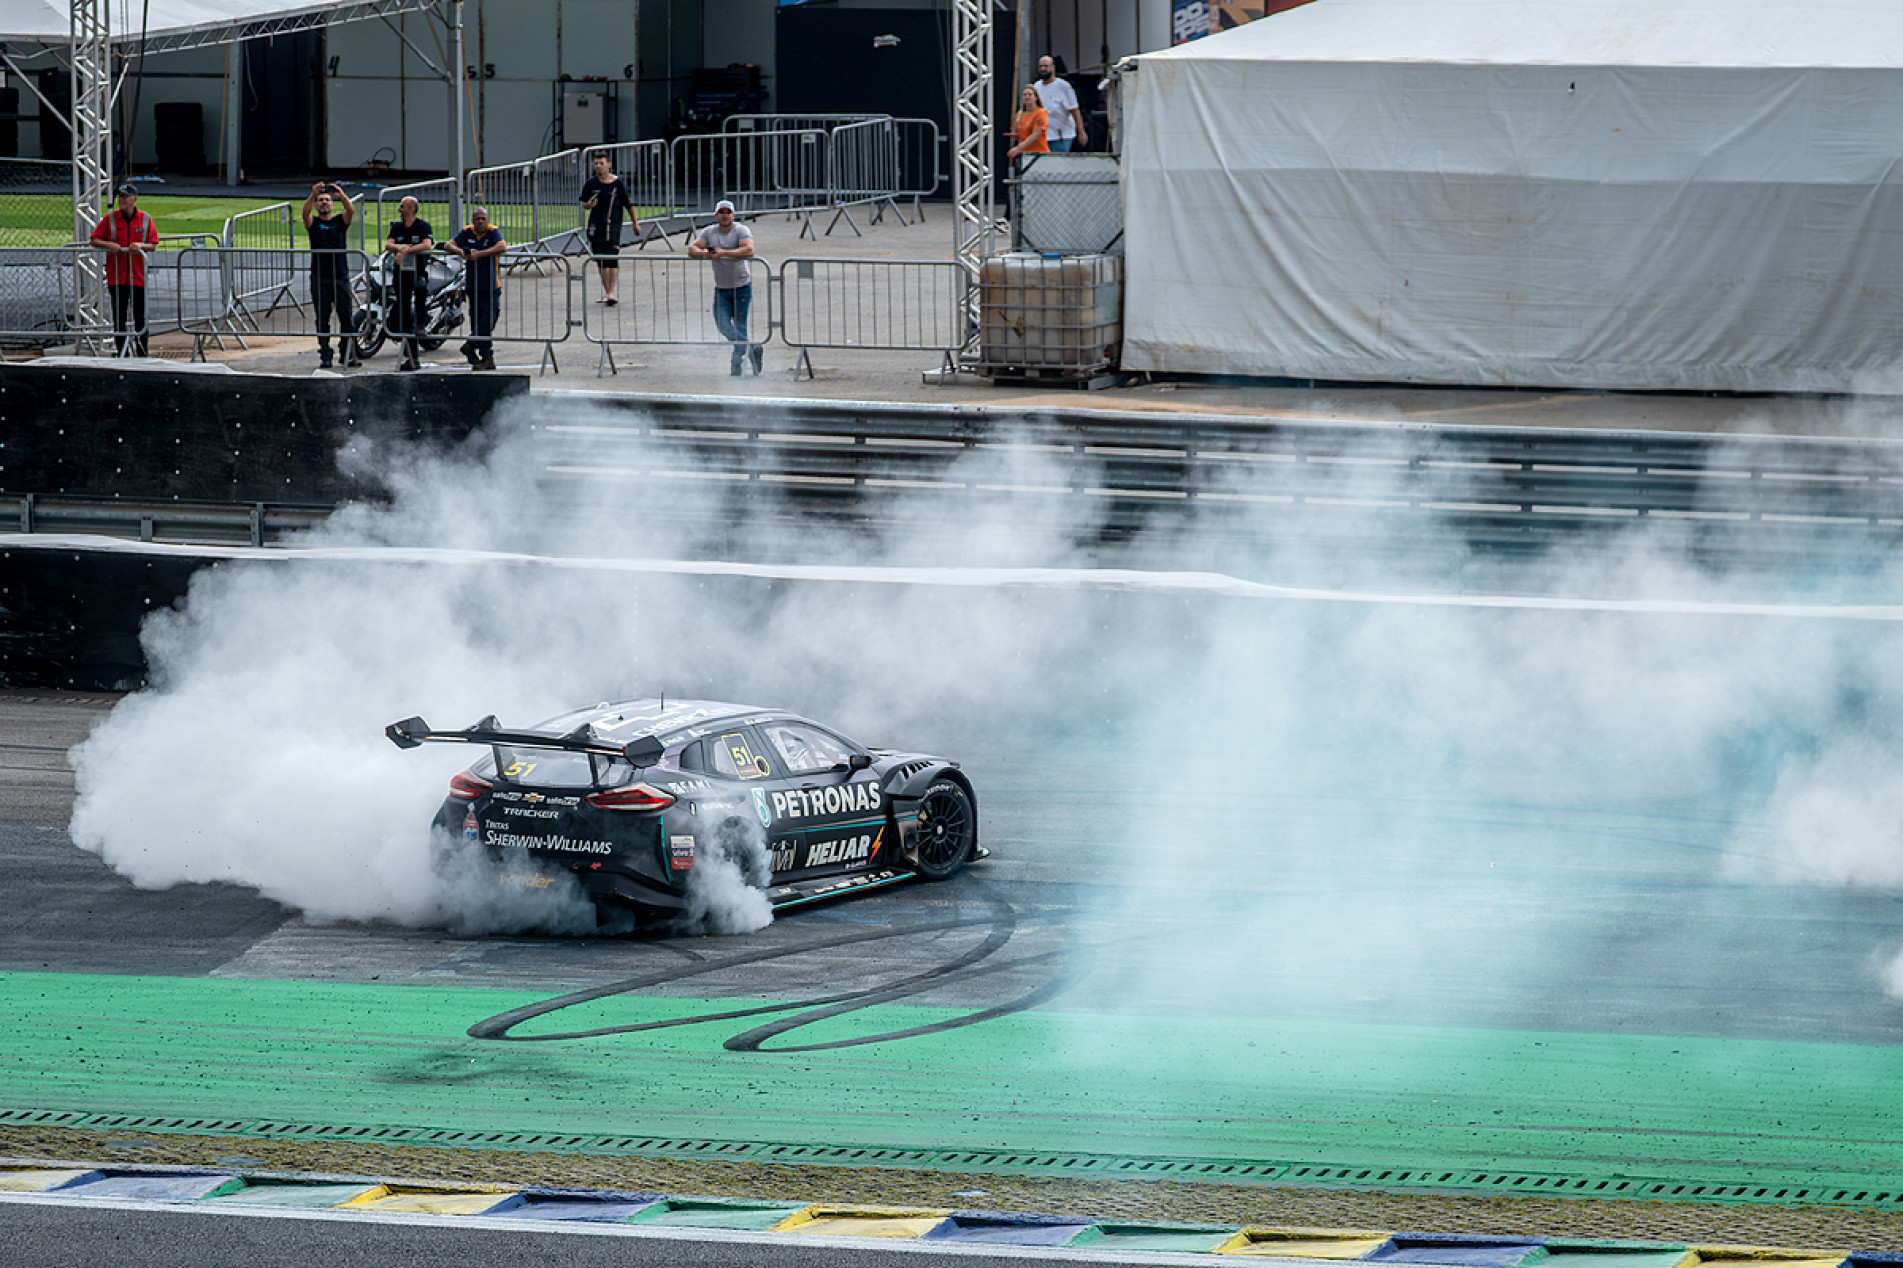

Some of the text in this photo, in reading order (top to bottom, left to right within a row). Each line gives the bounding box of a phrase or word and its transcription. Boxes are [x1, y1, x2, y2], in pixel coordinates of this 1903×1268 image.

[484, 63, 496, 79] 5
[624, 63, 633, 79] 6
[731, 745, 753, 766] 51
[503, 762, 537, 777] 51
[771, 782, 881, 819] PETRONAS
[503, 806, 559, 819] TRACKER
[804, 834, 871, 868] HELIAR
